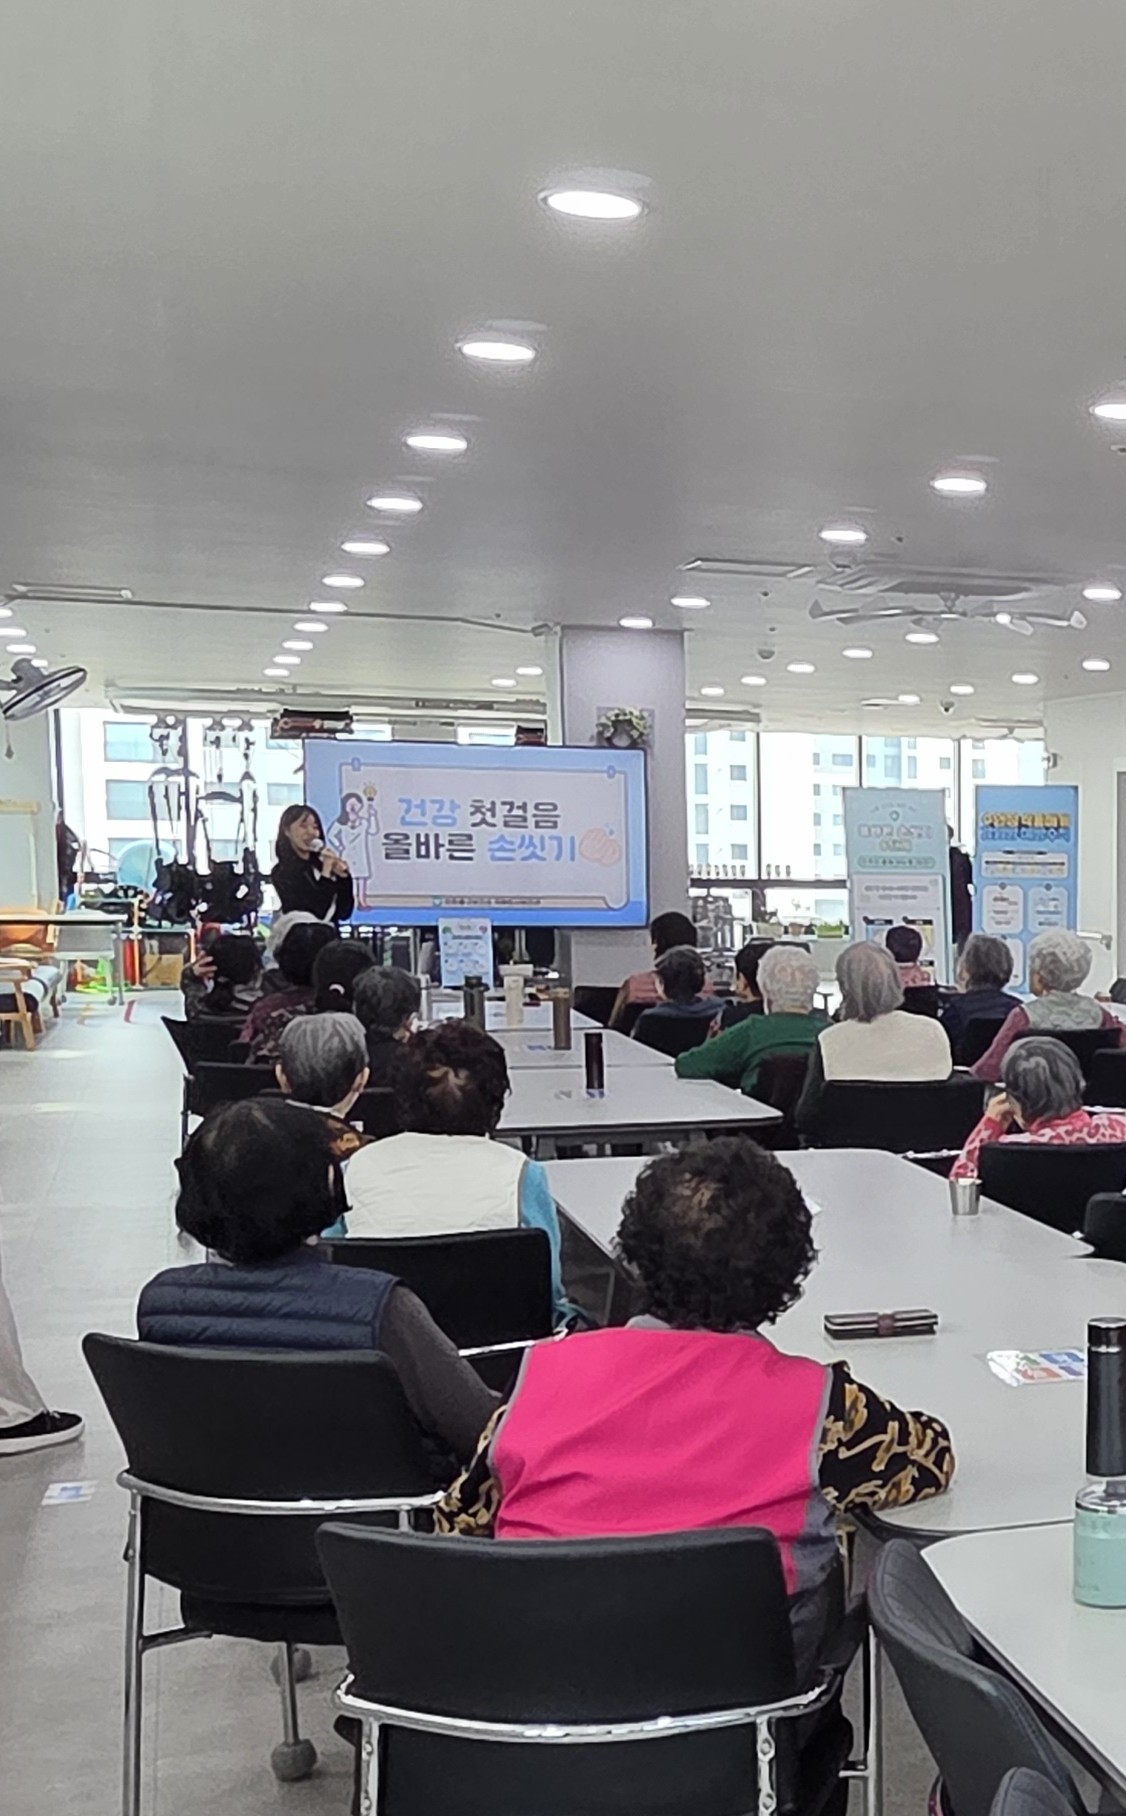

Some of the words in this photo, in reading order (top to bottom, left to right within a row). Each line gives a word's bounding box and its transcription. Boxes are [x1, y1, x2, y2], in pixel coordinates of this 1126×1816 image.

[398, 797, 461, 828] 건강
[468, 798, 561, 829] 첫걸음
[381, 832, 476, 861] 올바른
[488, 833, 576, 862] 손씻기
